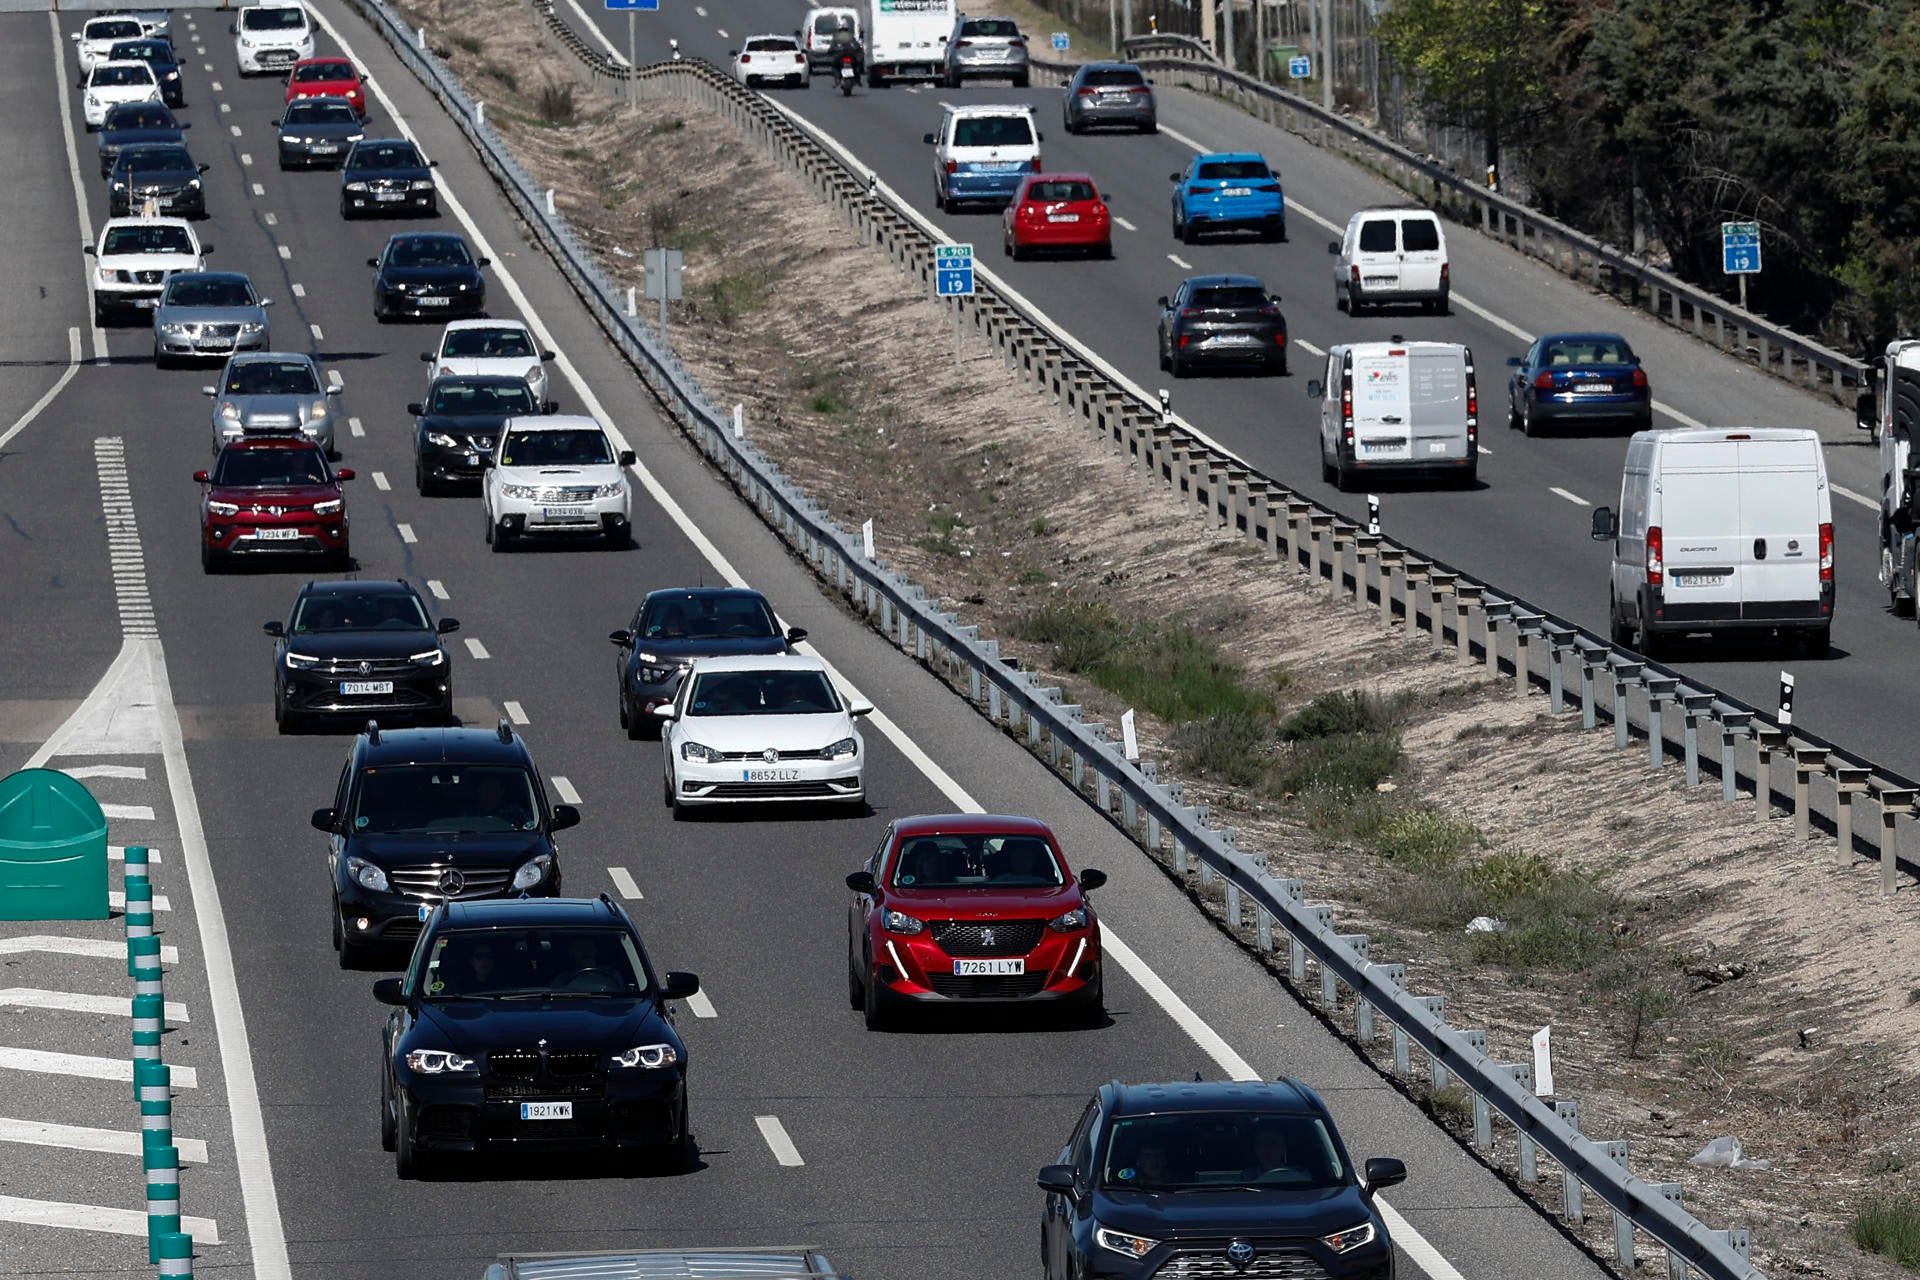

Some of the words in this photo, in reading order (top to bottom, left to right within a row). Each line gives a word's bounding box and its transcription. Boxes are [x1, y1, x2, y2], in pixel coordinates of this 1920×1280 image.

[1734, 257, 1750, 269] 19
[948, 280, 963, 292] 19
[346, 683, 370, 693] 7014
[373, 682, 390, 692] MBT
[750, 770, 776, 781] 8652
[779, 769, 799, 780] LLZ
[962, 961, 993, 974] 7261
[998, 960, 1022, 973] LYW
[530, 1106, 550, 1117] 1921
[552, 1105, 570, 1116] KWK
